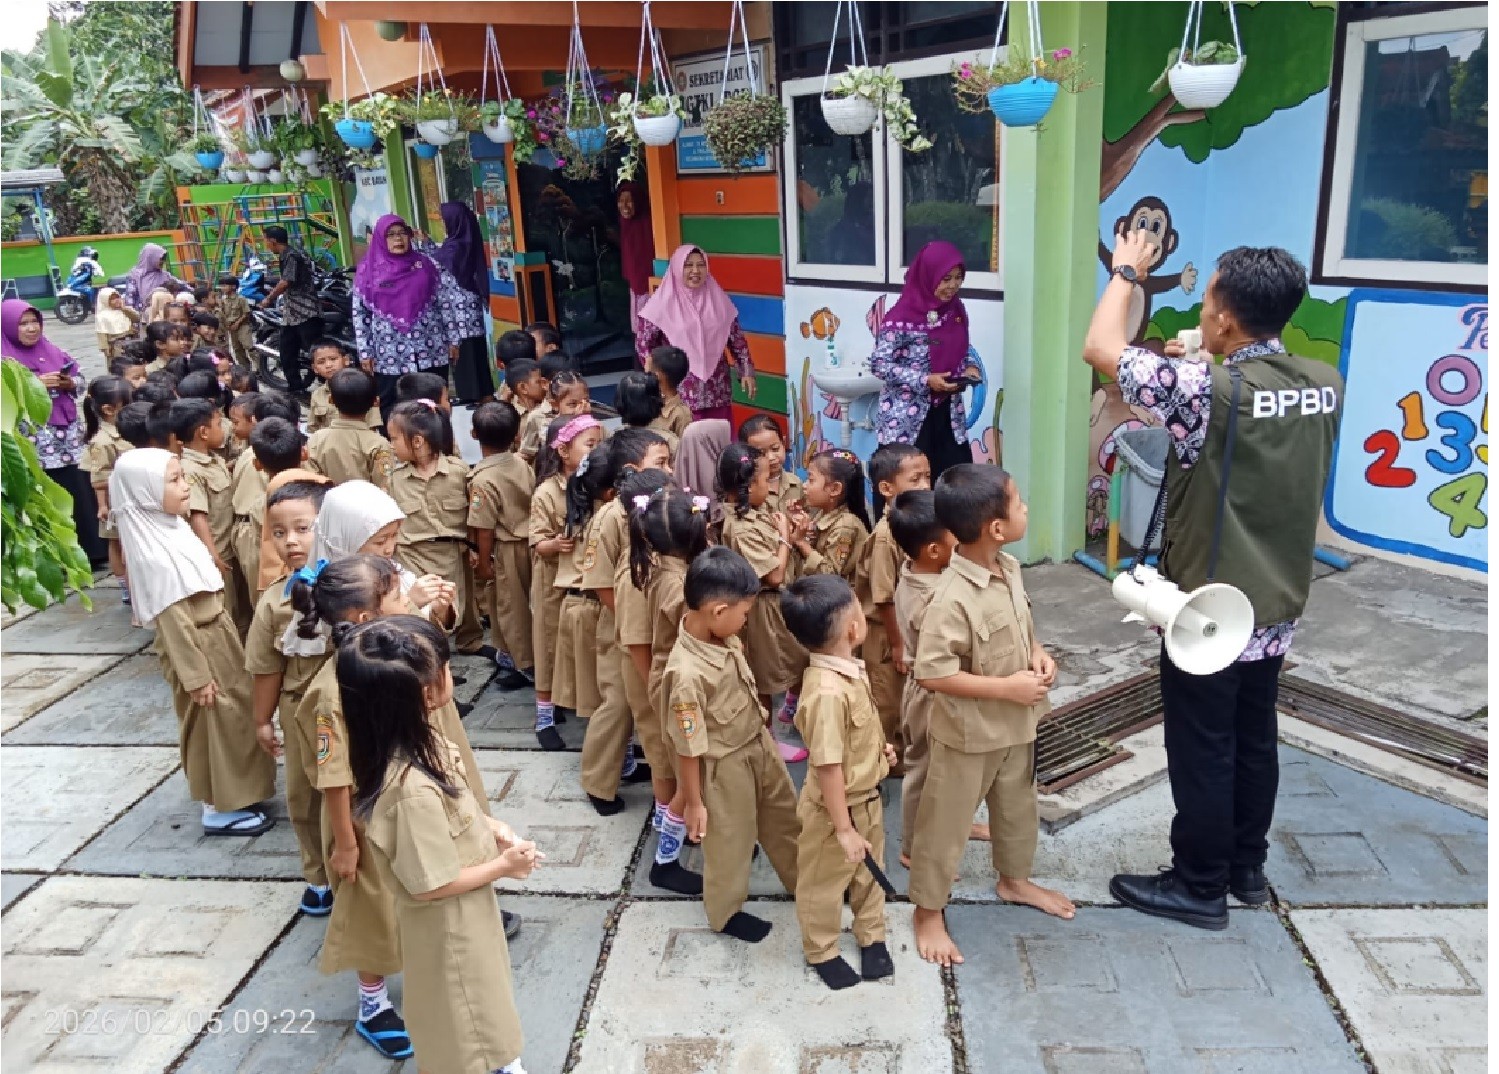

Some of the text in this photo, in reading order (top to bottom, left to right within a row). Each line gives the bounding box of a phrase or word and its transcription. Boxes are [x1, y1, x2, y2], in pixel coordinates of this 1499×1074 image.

[1253, 386, 1336, 418] BPBD
[1396, 390, 1429, 441] 1
[1364, 429, 1417, 488] 2
[1425, 410, 1477, 475] 3
[1427, 471, 1488, 538] 4
